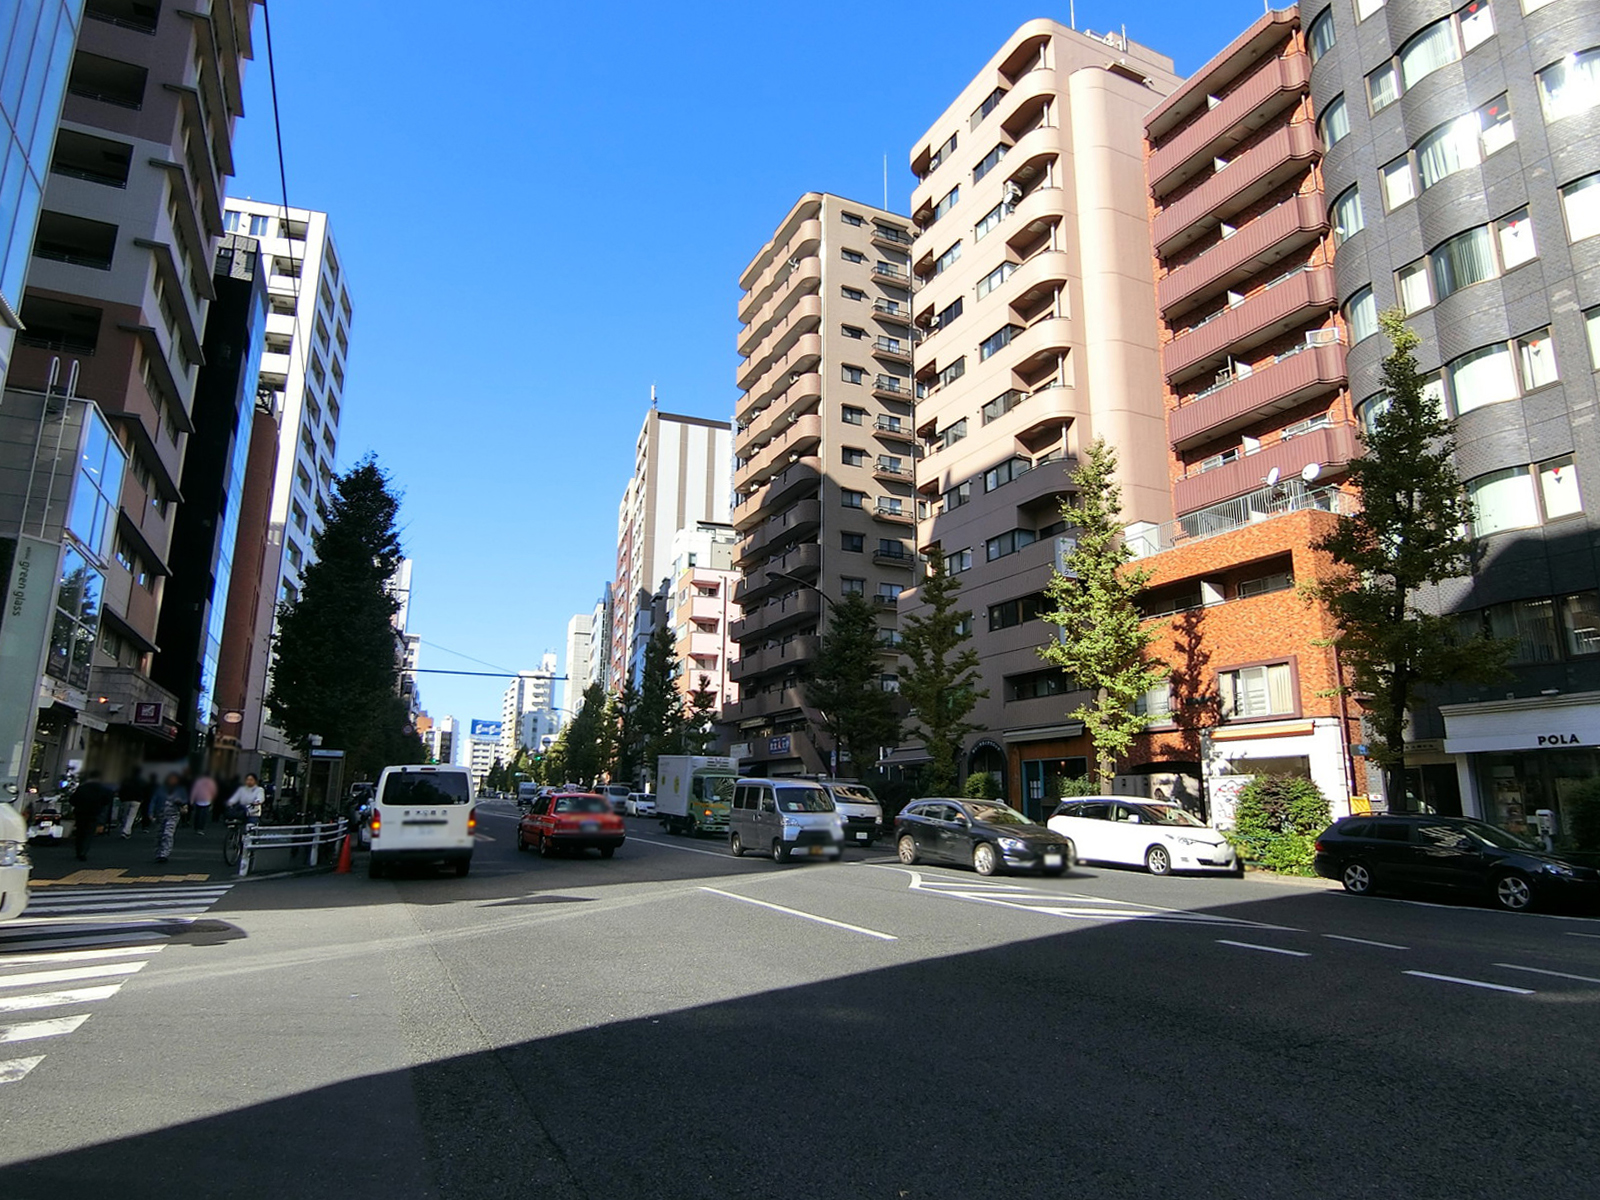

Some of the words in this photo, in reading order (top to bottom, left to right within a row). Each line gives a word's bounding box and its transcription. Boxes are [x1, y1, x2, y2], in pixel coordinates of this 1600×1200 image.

[18, 560, 30, 589] green
[12, 590, 26, 616] glass
[1537, 733, 1580, 746] POLA
